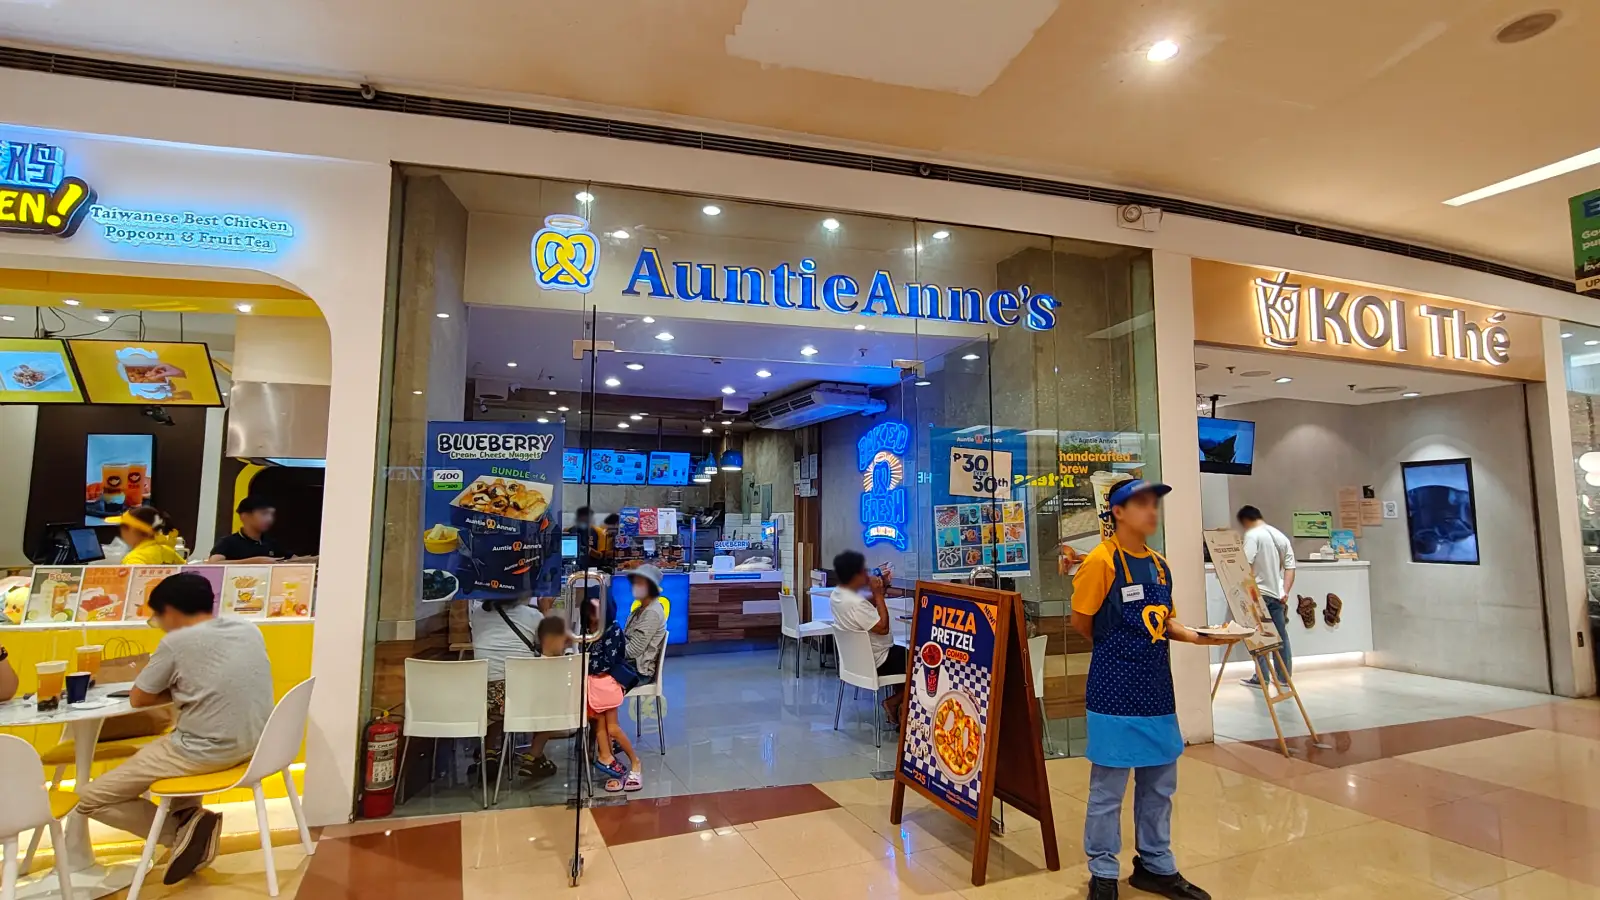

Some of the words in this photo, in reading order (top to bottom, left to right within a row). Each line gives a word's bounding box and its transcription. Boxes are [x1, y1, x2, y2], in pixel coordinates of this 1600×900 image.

[91, 206, 179, 225] Taiwanese
[184, 213, 219, 226] Best
[224, 215, 288, 231] Chicken
[106, 225, 175, 240] Popcorn
[181, 231, 194, 242] &
[200, 232, 241, 247] Fruit
[244, 235, 270, 248] Tea
[621, 246, 858, 314] Auntie
[859, 269, 1056, 332] Anne's
[1308, 286, 1407, 352] KOI
[1419, 304, 1511, 366] Thé
[438, 434, 553, 452] BLUEBERRY
[858, 422, 908, 470] BAKED
[480, 451, 506, 459] Cheese
[508, 451, 541, 460] Nuggets
[1059, 450, 1131, 462] handcrafted
[491, 466, 531, 479] BUNDLE
[540, 473, 546, 481] 4
[1060, 463, 1088, 474] brew
[972, 476, 1009, 493] 30th
[862, 488, 904, 523] FRESH
[465, 517, 486, 526] Auntie
[496, 523, 517, 532] Anne's
[714, 540, 750, 548] BLUEBERRY
[932, 604, 976, 635] PIZZA
[984, 604, 997, 626] NEW!
[931, 625, 976, 653] PRETZEL
[947, 649, 968, 661] COMBO
